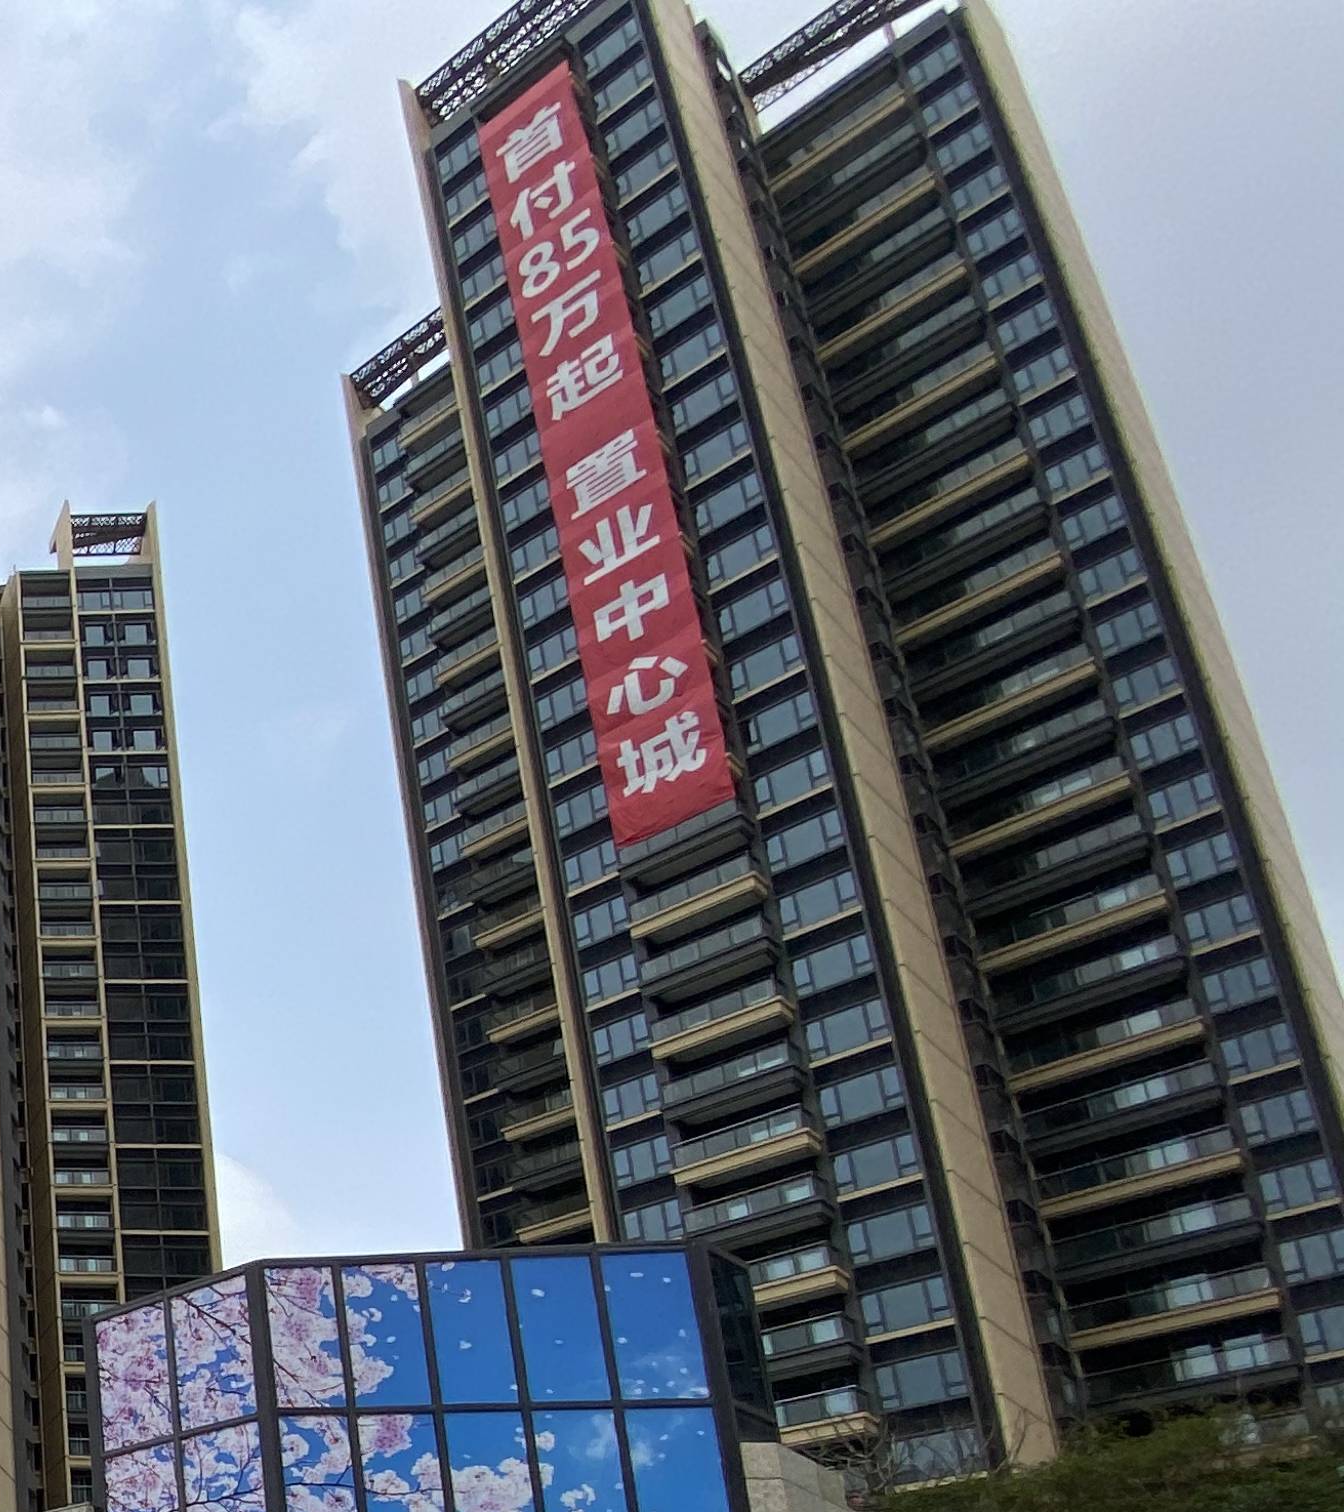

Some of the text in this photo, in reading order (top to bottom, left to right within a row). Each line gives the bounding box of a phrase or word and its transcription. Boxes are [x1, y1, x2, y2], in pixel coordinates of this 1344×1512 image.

[496, 101, 707, 798] 首付85万起 置业中心城
